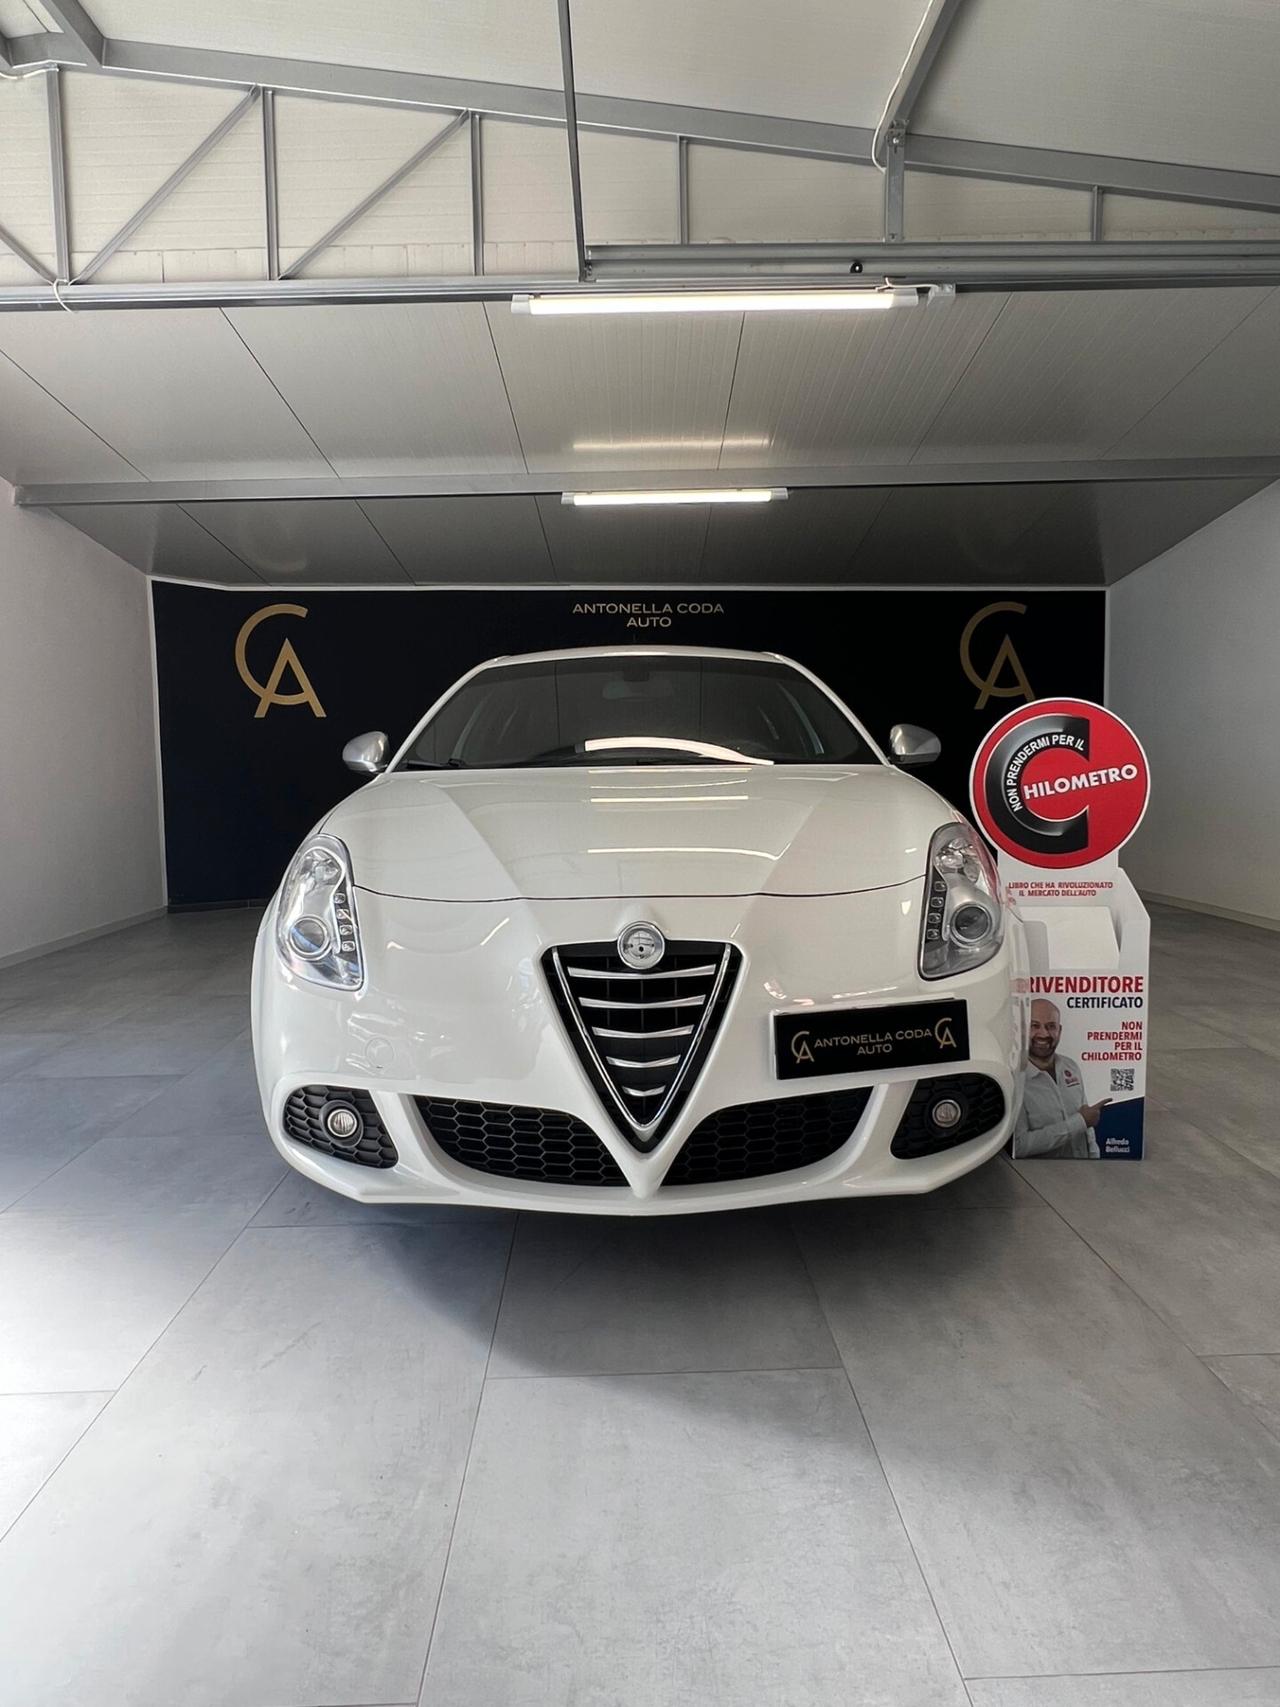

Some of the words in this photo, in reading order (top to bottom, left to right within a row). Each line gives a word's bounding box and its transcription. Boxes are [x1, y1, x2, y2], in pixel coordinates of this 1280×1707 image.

[572, 603, 673, 614] ANTONELLA
[676, 603, 724, 614] CODA
[626, 617, 672, 627] AUTO
[1052, 734, 1075, 747] PER
[1074, 738, 1085, 751] IL
[1006, 736, 1050, 786] PRENDERMI
[1023, 763, 1138, 800] HILOMETRO
[1006, 788, 1023, 812] NON
[1008, 881, 1029, 889] LIBRO
[1030, 881, 1043, 889] CHE
[1045, 881, 1055, 889] HA
[1058, 881, 1113, 889] RIVOLUZIONATO
[1018, 889, 1025, 897] IL
[1028, 889, 1060, 897] MERCATO
[1061, 889, 1097, 897] DELL'AUTO
[1067, 996, 1143, 1009] CERTIFICATO
[1121, 1021, 1142, 1030] NON
[814, 1032, 893, 1049] ANTONELLA
[895, 1028, 933, 1041] CODA
[1087, 1031, 1142, 1040] PRENDERMI
[856, 1043, 892, 1056] AUTO
[1114, 1042, 1132, 1050] PER
[1134, 1042, 1143, 1050] IL
[1081, 1052, 1142, 1061] CHILOMETRO
